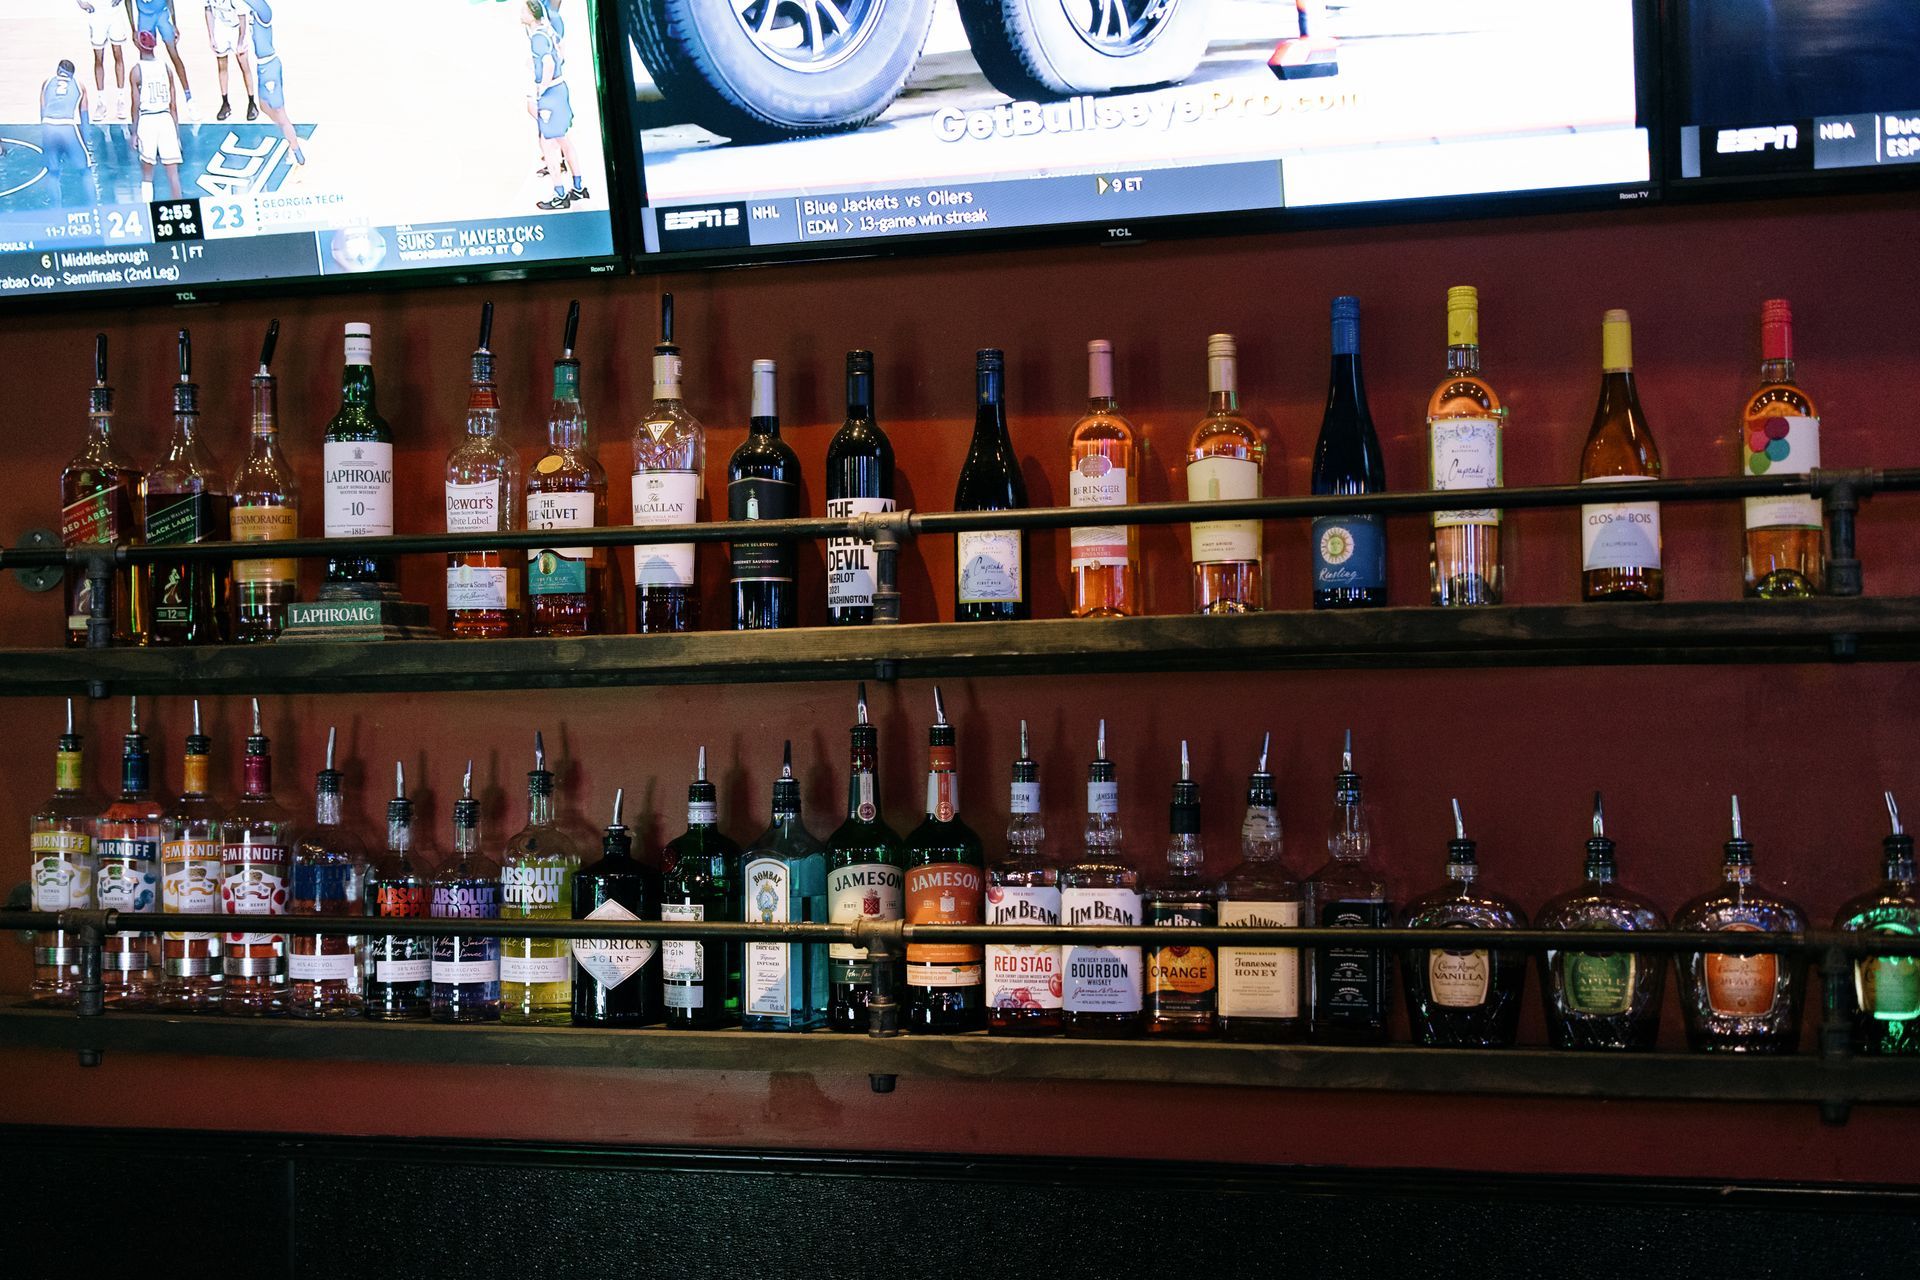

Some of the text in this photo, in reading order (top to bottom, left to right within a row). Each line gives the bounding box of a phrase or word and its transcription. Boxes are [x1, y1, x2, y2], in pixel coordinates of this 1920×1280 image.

[149, 82, 168, 103] 14
[1717, 125, 1798, 153] ESPN
[1820, 122, 1855, 140] NBA
[1111, 176, 1143, 193] 9 ET
[262, 194, 344, 209] GEORGIA TECH
[804, 190, 974, 216] Blue Jackets vs Oilers
[1638, 191, 1649, 199] TV
[68, 212, 90, 224] PITT
[158, 203, 193, 221] 2:55
[210, 204, 245, 230] 23
[751, 206, 780, 220] NHL
[107, 211, 143, 239] 24
[157, 222, 197, 238] 30 1st
[807, 208, 989, 236] EDM 13-game win streak
[397, 225, 545, 250] SUNS AT MAVERICKS
[1108, 228, 1132, 237] TCL
[41, 245, 204, 269] 6 Middlesbrough 1 FT
[606, 264, 614, 272] TV
[31, 273, 55, 289] Cup
[63, 269, 122, 285] Semifinals
[124, 267, 151, 283] (2nd
[153, 265, 180, 282] Leg)
[176, 291, 196, 301] TCL
[653, 424, 663, 433] 12
[326, 469, 392, 483] LAPHROAIG
[1448, 458, 1486, 481] Cupcake
[351, 501, 365, 516] 10
[447, 495, 494, 511] Dewar's
[540, 499, 555, 509] THE
[634, 504, 684, 513] MACALLAN
[828, 501, 854, 518] THE
[62, 520, 80, 535] RED
[81, 507, 113, 526] LABEL
[528, 508, 578, 522] GLENLIVET
[1588, 513, 1614, 526] CLOS
[1628, 512, 1652, 524] BOIS
[147, 514, 196, 539] BLACK LABEL
[828, 549, 870, 571] DEVIL
[828, 572, 855, 583] MERLOT
[828, 595, 869, 605] WASHINGTON
[167, 609, 177, 619] 12
[293, 606, 375, 624] LAPHROAIG
[165, 843, 220, 859] SMIRNOF
[222, 847, 284, 861] SMIRNOFF
[501, 866, 565, 885] ABSOLUT
[753, 870, 782, 886] BOMBAY
[835, 871, 902, 892] JAMESON
[911, 871, 980, 893] JAMESON
[433, 887, 495, 904] ABSOLUT
[504, 884, 559, 903] CITRON
[992, 900, 1059, 925] JIM BEAM
[1067, 900, 1134, 925] JIM BEAM
[599, 955, 624, 963] GIN
[994, 955, 1053, 973] RED STAG
[1235, 957, 1278, 968] Tennessee
[1071, 963, 1128, 978] BOURBON
[1151, 966, 1208, 979] ORANGE
[1234, 969, 1278, 977] HONEY
[1434, 972, 1484, 981] VANILLA
